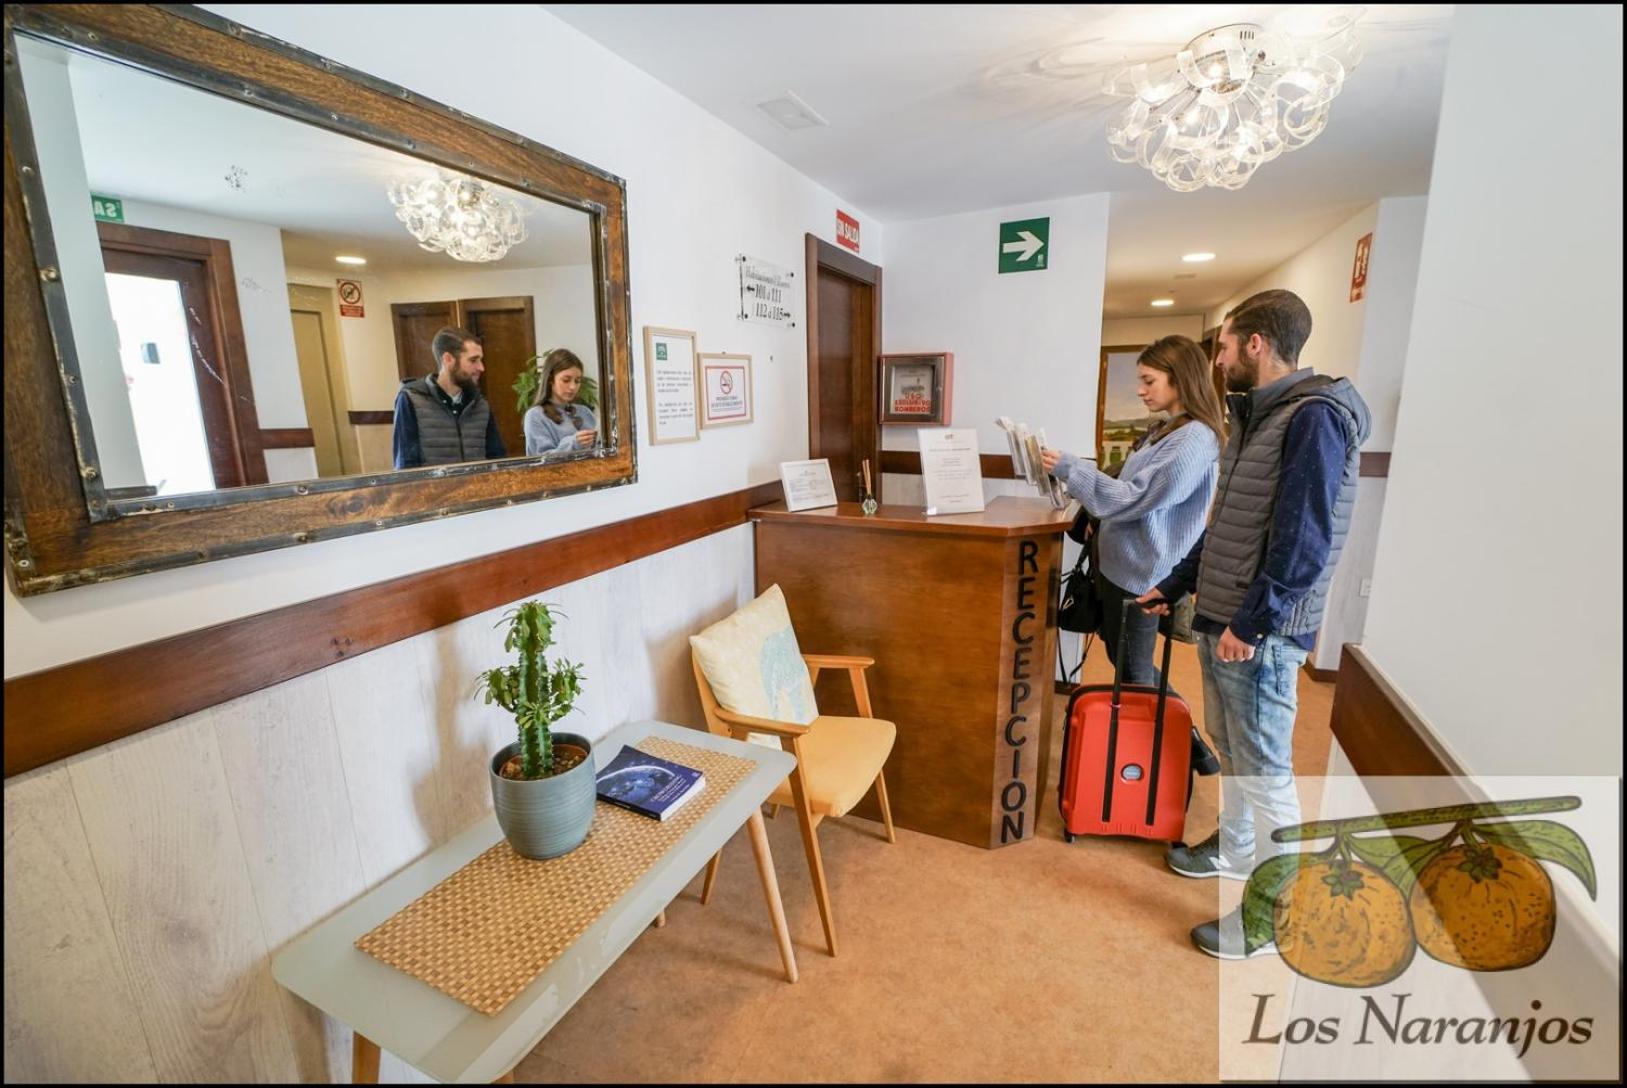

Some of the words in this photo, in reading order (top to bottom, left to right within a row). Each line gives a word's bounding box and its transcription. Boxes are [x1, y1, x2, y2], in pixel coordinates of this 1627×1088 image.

[771, 287, 782, 303] 111
[756, 302, 767, 317] 112
[1000, 540, 1039, 844] RECEPCION
